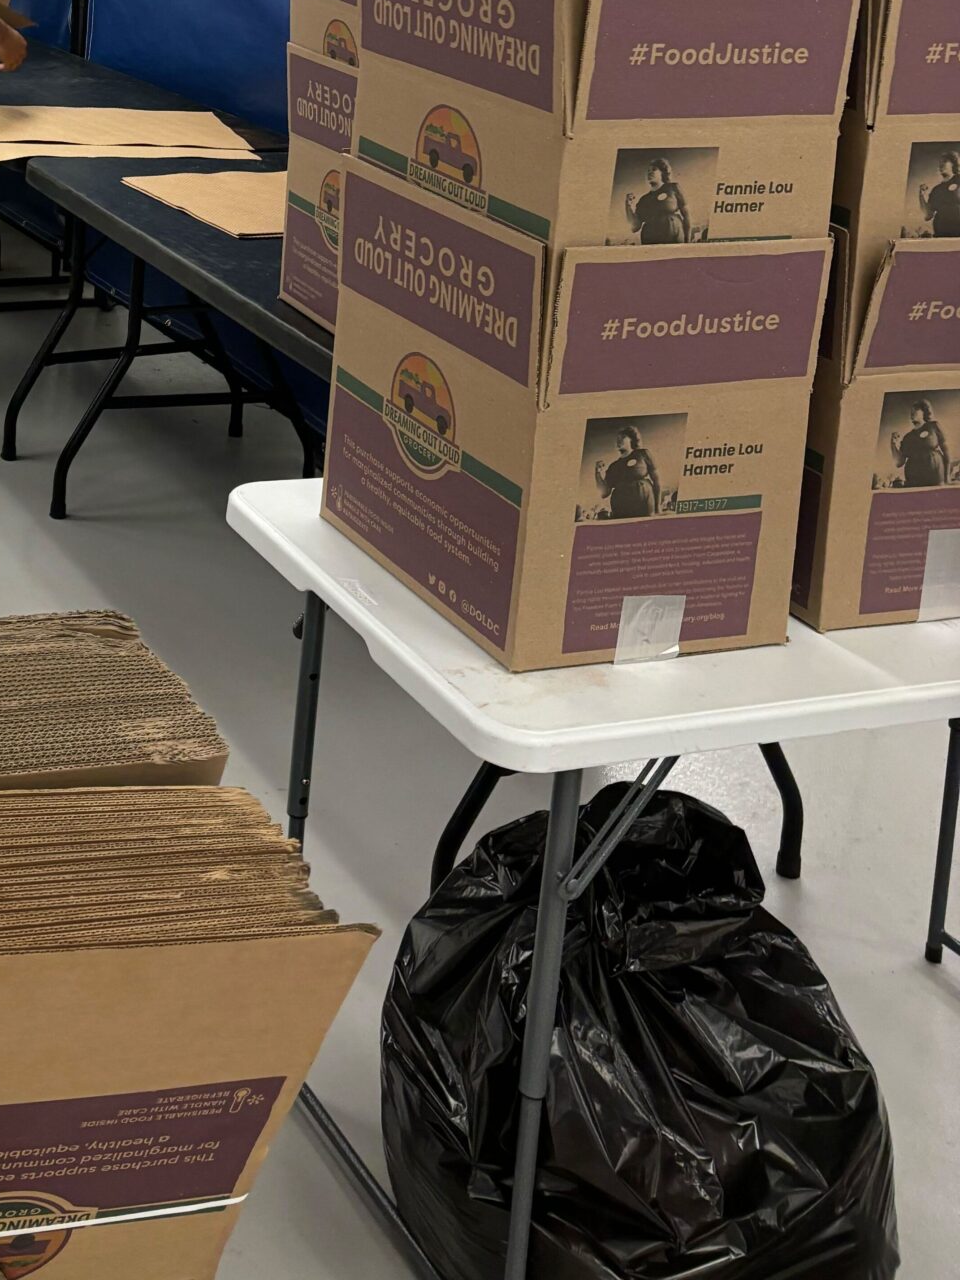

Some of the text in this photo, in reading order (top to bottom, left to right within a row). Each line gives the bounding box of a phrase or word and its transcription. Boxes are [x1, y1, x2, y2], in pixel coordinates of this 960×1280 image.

[414, 9, 446, 44] OUT
[449, 20, 540, 76] DREAMING
[629, 42, 809, 66] #FoodJustice
[297, 97, 317, 123] LOUD
[409, 162, 486, 210] DREAMING OUT LOUD
[716, 181, 793, 196] Fannie Lou
[714, 199, 764, 213] Hamer
[354, 237, 391, 280] LOUD
[374, 216, 495, 297] GROCERY
[394, 257, 426, 297] OUT
[429, 274, 517, 348] DREAMING
[601, 310, 780, 340] #FoodJustice
[385, 403, 460, 464] DREAMING OUT LOUD
[403, 435, 436, 462] GROCERY
[685, 443, 763, 459] Fannie Lou
[683, 462, 734, 477] Hamer
[356, 446, 384, 471] purchase
[385, 467, 414, 493] supports
[415, 488, 449, 519] economic
[449, 513, 501, 556] opportunities
[678, 499, 728, 512] 1917-1977
[352, 456, 393, 491] marginalized
[393, 488, 436, 524] communities
[437, 519, 466, 545] through
[467, 541, 499, 572] building
[392, 501, 425, 531] equitable
[426, 525, 443, 544] food
[444, 539, 472, 566] system.
[461, 599, 500, 636] @DOLDC
[590, 622, 609, 631] Read
[117, 1099, 226, 1117] HANDLE WITH CARE
[155, 1090, 231, 1104] REFRIGERATE
[80, 1107, 223, 1128] PERISHABLE FOOD INSIDE
[81, 1143, 193, 1164] marginalized
[85, 1136, 154, 1150] healthy,
[197, 1140, 220, 1150] for
[100, 1155, 179, 1172] purchase
[184, 1152, 215, 1164] This
[21, 1165, 97, 1180] supports
